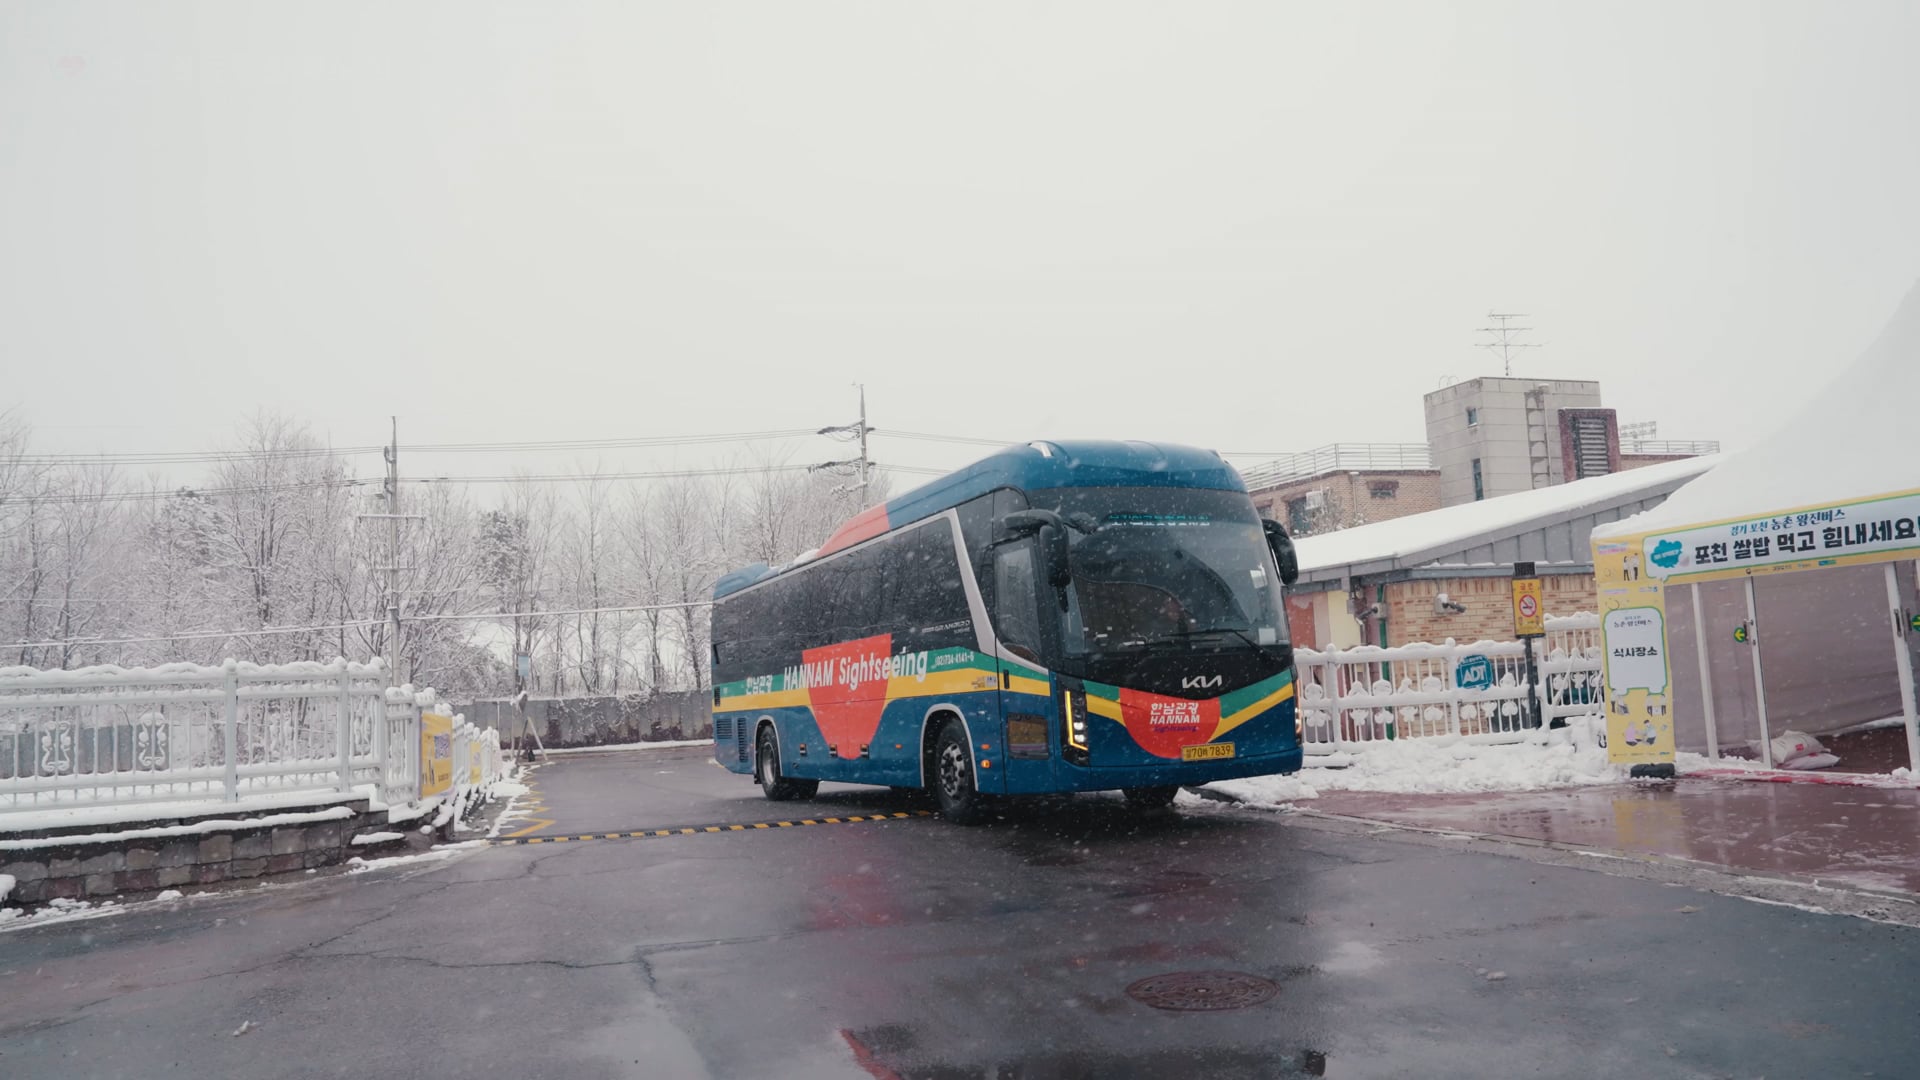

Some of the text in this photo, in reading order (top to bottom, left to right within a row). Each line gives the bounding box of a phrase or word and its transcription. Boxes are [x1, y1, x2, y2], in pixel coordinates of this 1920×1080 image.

[1771, 517, 1793, 531] 농촌
[1796, 508, 1846, 526] 왕진버스
[1695, 542, 1728, 565] 포천
[1733, 536, 1770, 560] 쌀밥
[1777, 530, 1816, 553] 먹고
[1613, 646, 1658, 658] 식사장소
[783, 646, 928, 691] HANNAM Sightseeing
[1462, 665, 1486, 684] ADT
[1151, 702, 1199, 715] 한남관광
[1150, 714, 1200, 725] HANNAM
[1209, 745, 1231, 756] 7839
